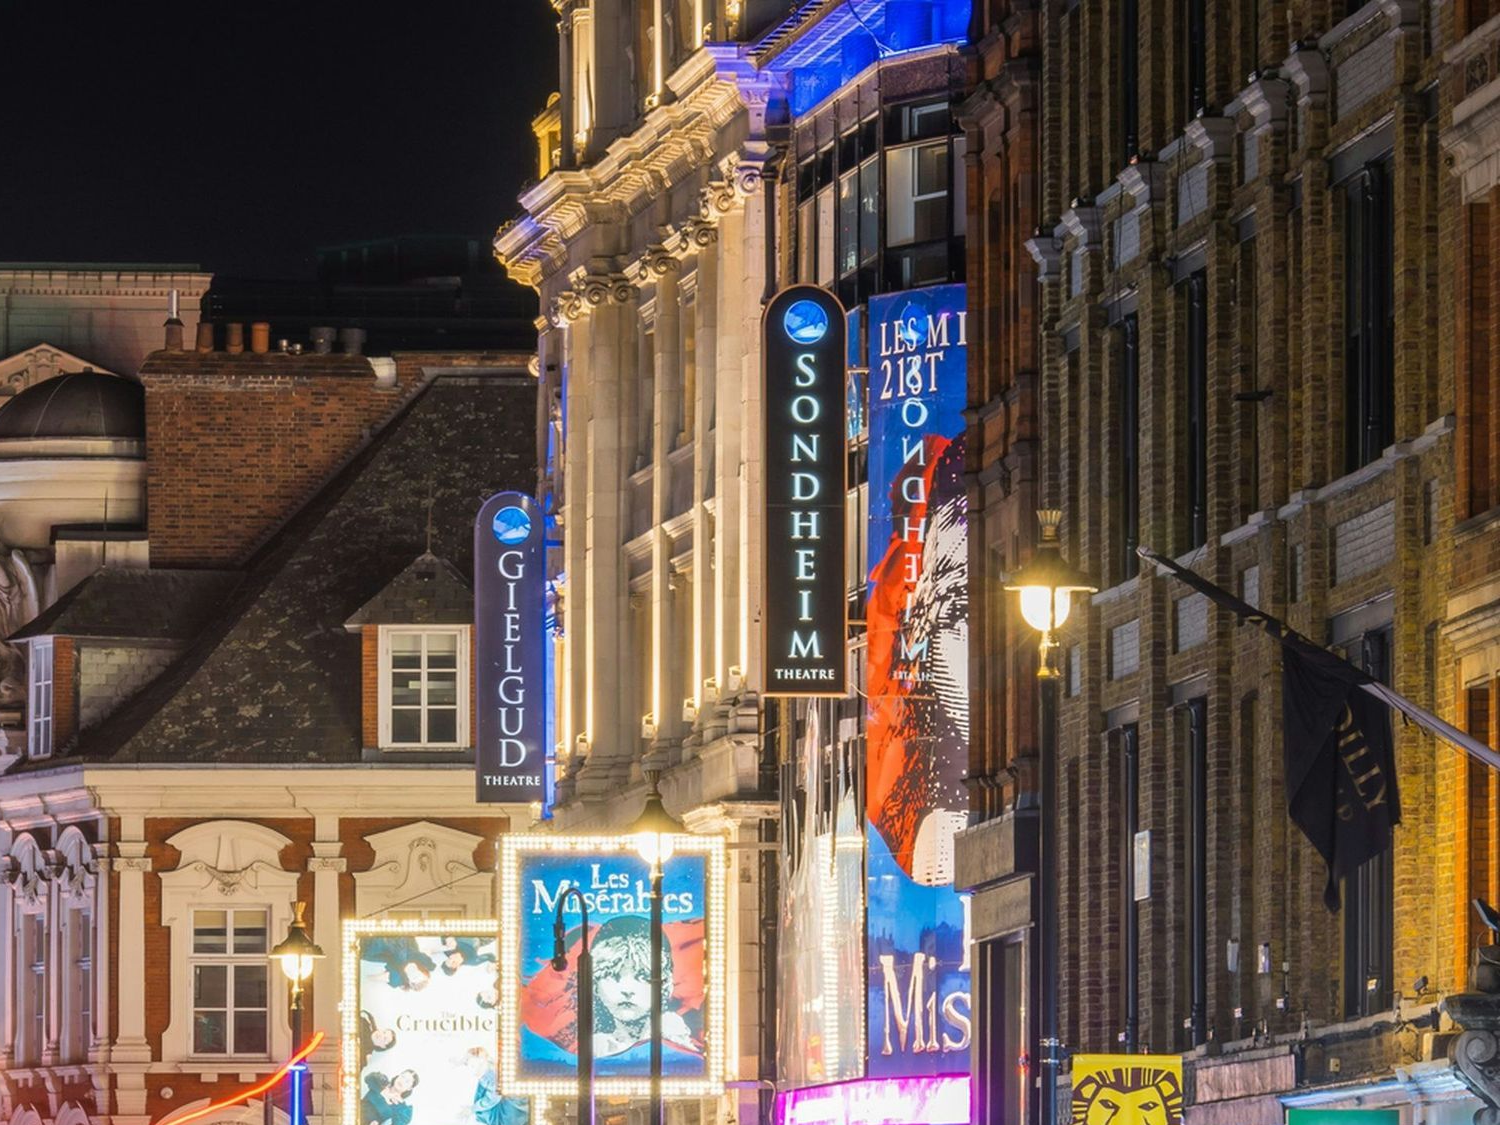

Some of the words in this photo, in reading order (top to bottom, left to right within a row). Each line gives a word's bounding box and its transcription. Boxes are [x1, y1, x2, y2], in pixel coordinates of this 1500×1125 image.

[787, 353, 824, 660] SONDHEIM
[498, 550, 527, 768] GIELGUD
[775, 667, 835, 681] THEATRE
[483, 775, 541, 786] THEATRE
[590, 863, 630, 890] Les
[531, 878, 694, 915] Misérabes
[396, 1014, 493, 1032] Crucible
